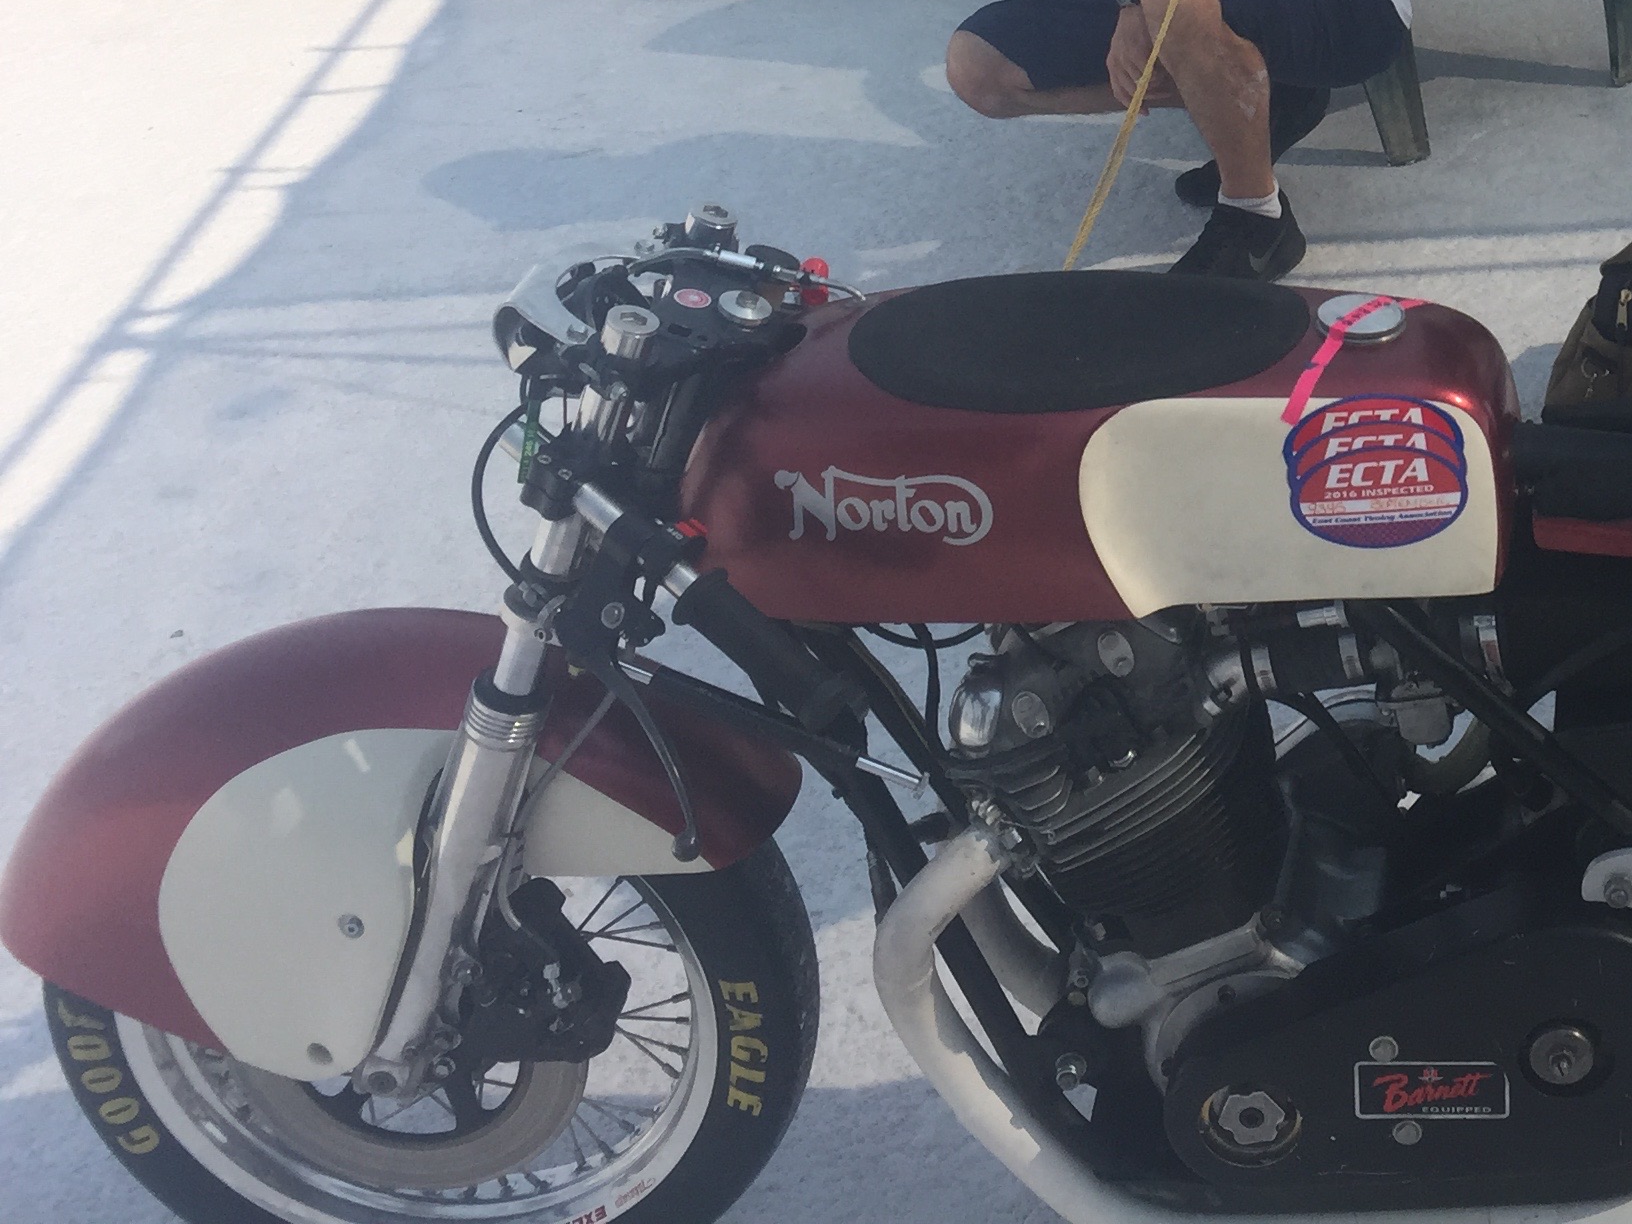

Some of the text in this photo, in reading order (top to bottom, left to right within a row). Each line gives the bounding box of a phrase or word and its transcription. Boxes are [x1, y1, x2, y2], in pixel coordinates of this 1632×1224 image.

[1325, 458, 1429, 489] ECTA
[774, 465, 993, 545] Norton
[1324, 484, 1434, 499] 2016 INSPECTED
[718, 979, 769, 1117] EAGLE
[1373, 1073, 1493, 1113] Barnett
[1421, 1106, 1492, 1114] EQUIPPED
